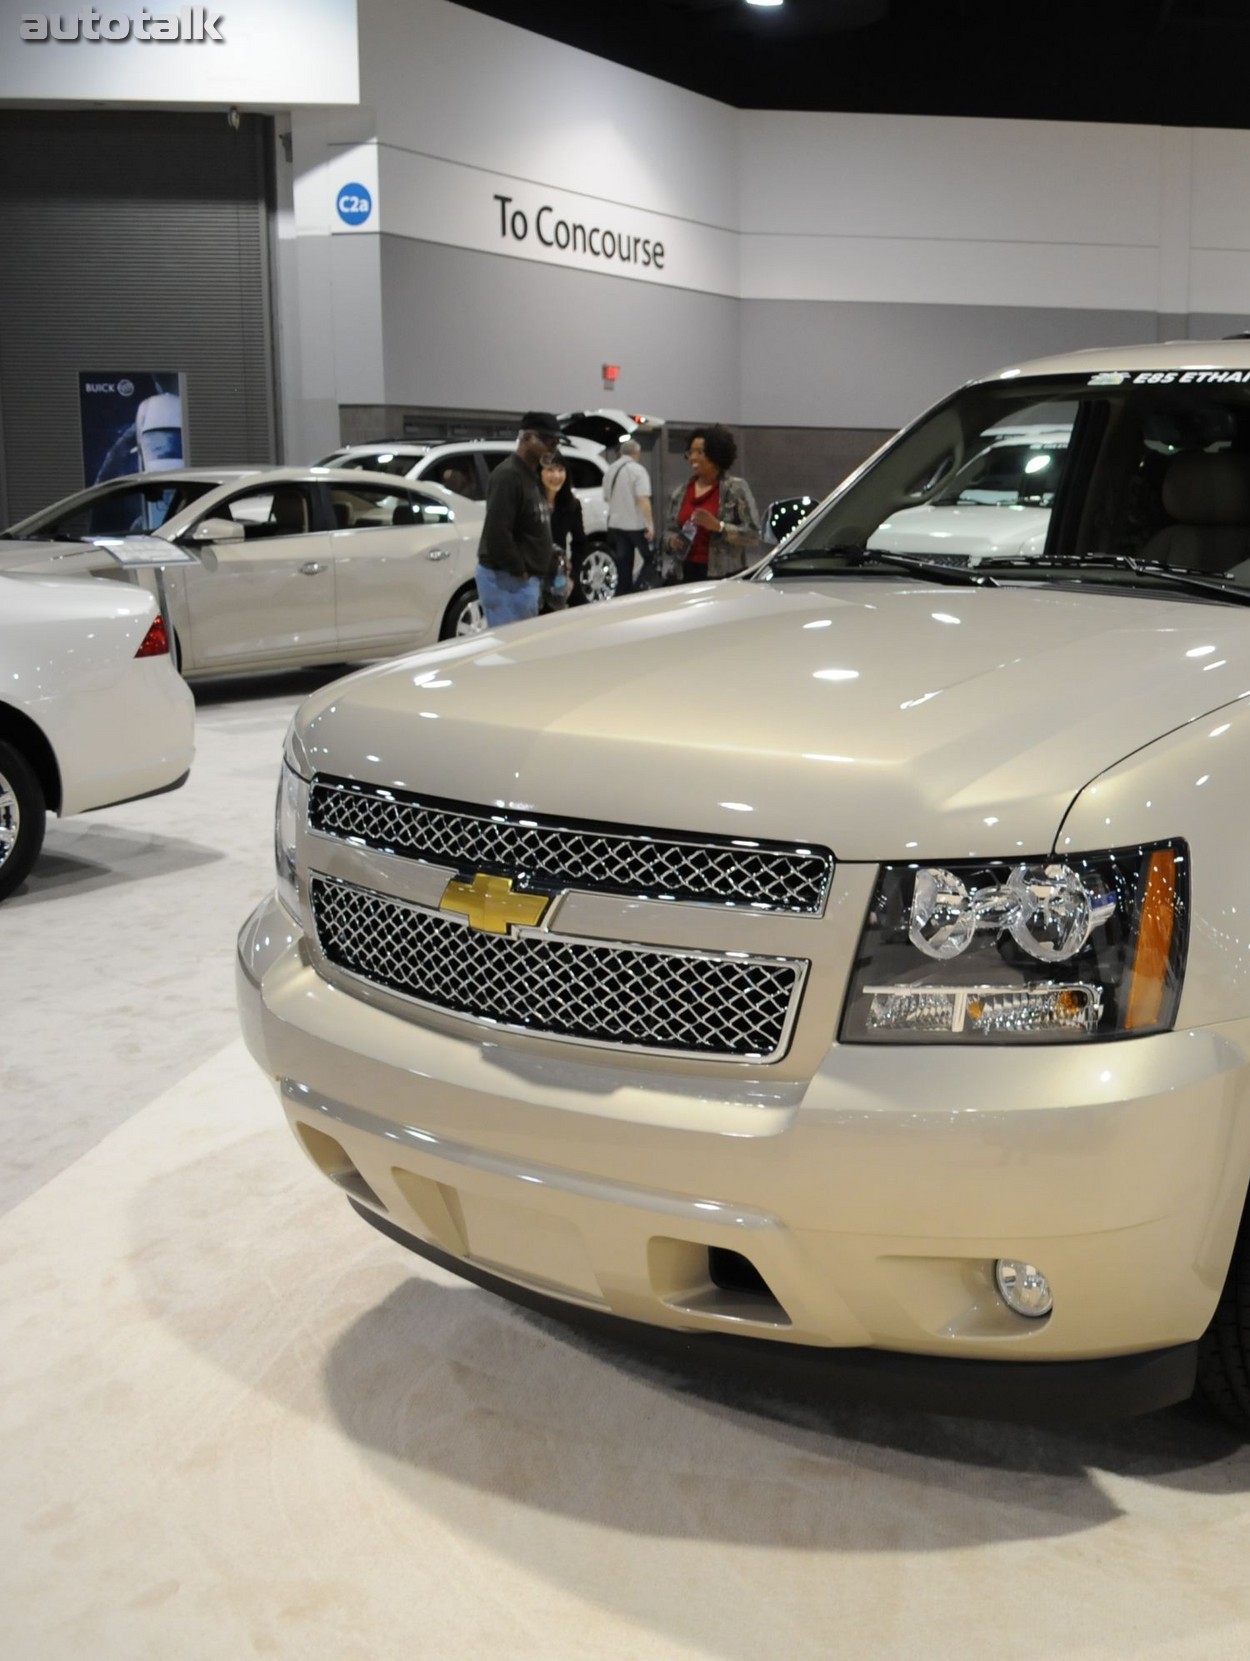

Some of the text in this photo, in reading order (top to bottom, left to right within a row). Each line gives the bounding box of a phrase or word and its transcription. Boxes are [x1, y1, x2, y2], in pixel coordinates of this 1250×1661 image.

[339, 195, 369, 213] C2a
[493, 194, 665, 270] To Concourse
[1133, 373, 1178, 384] E85
[85, 382, 115, 393] BUICK
